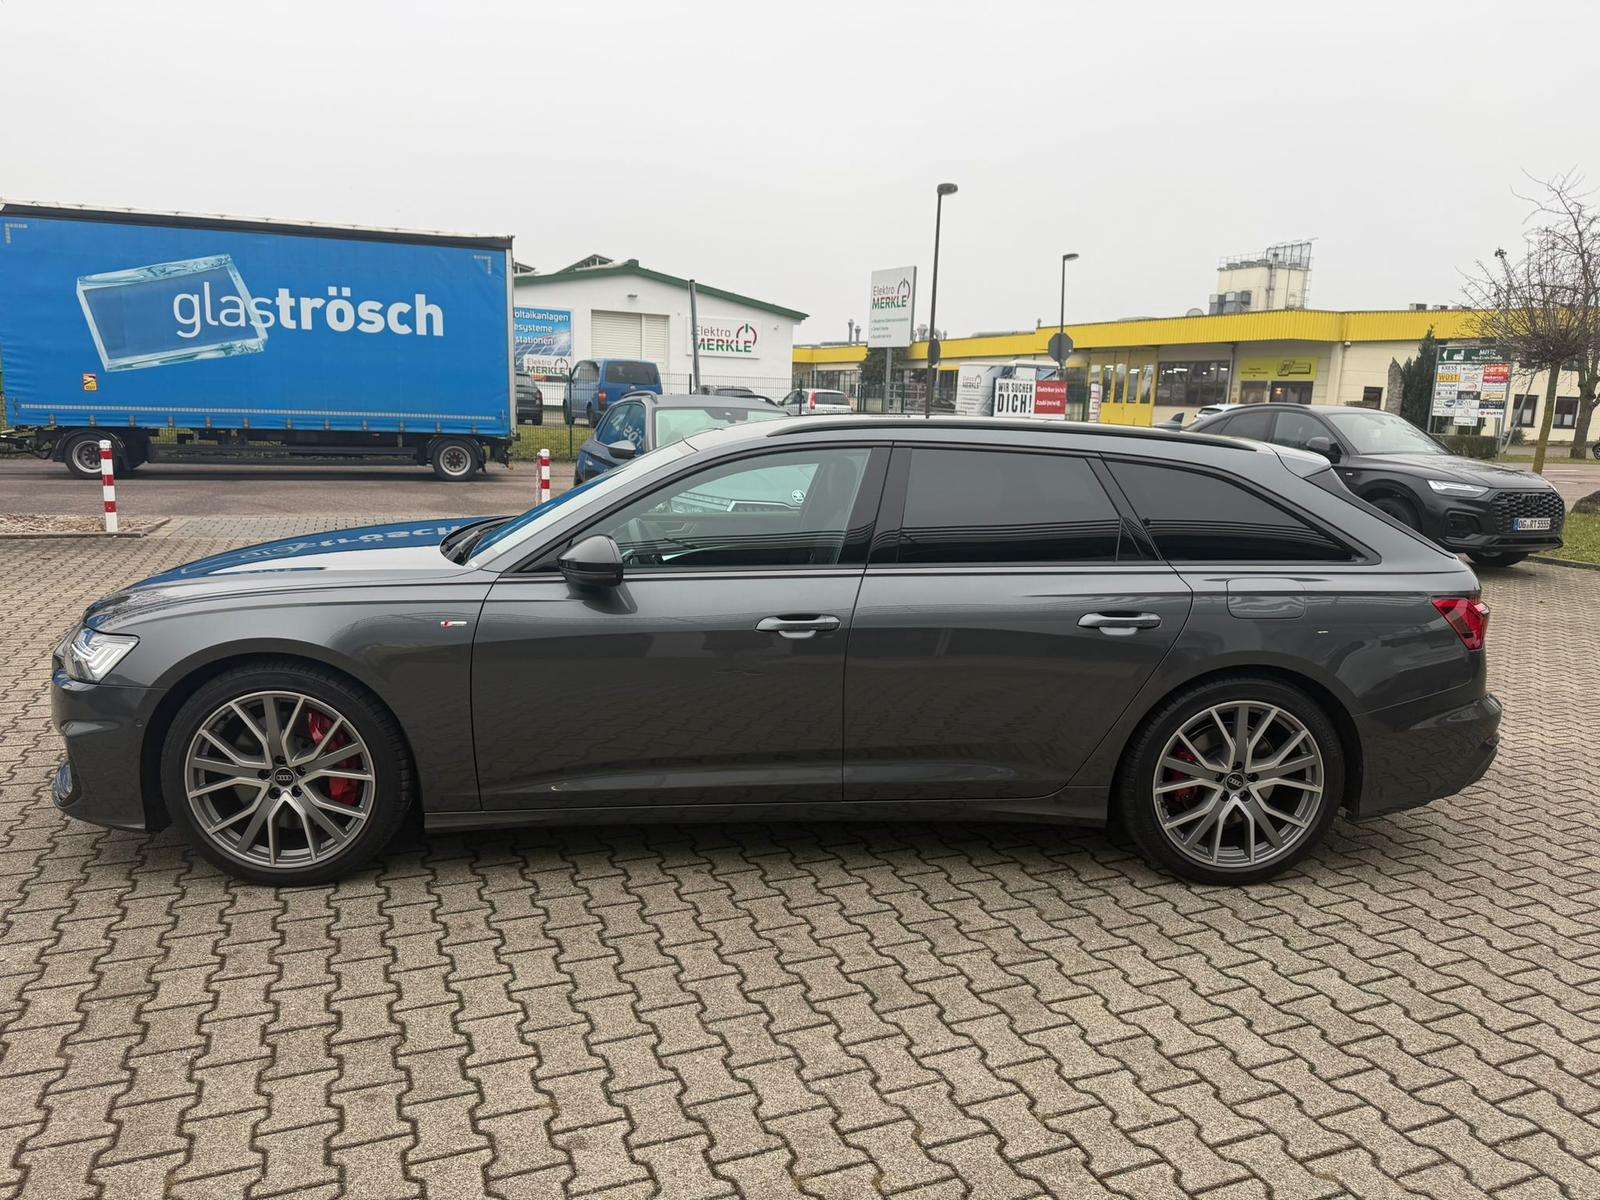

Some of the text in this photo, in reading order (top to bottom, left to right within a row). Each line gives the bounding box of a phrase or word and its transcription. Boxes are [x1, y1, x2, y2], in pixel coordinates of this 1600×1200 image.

[873, 285, 895, 297] Elektro
[872, 295, 907, 310] MERKLE
[173, 281, 443, 338] glaströsch
[526, 366, 566, 375] MERKLE
[998, 382, 1033, 393] WIR SUCHEN
[997, 393, 1032, 413] DICH!
